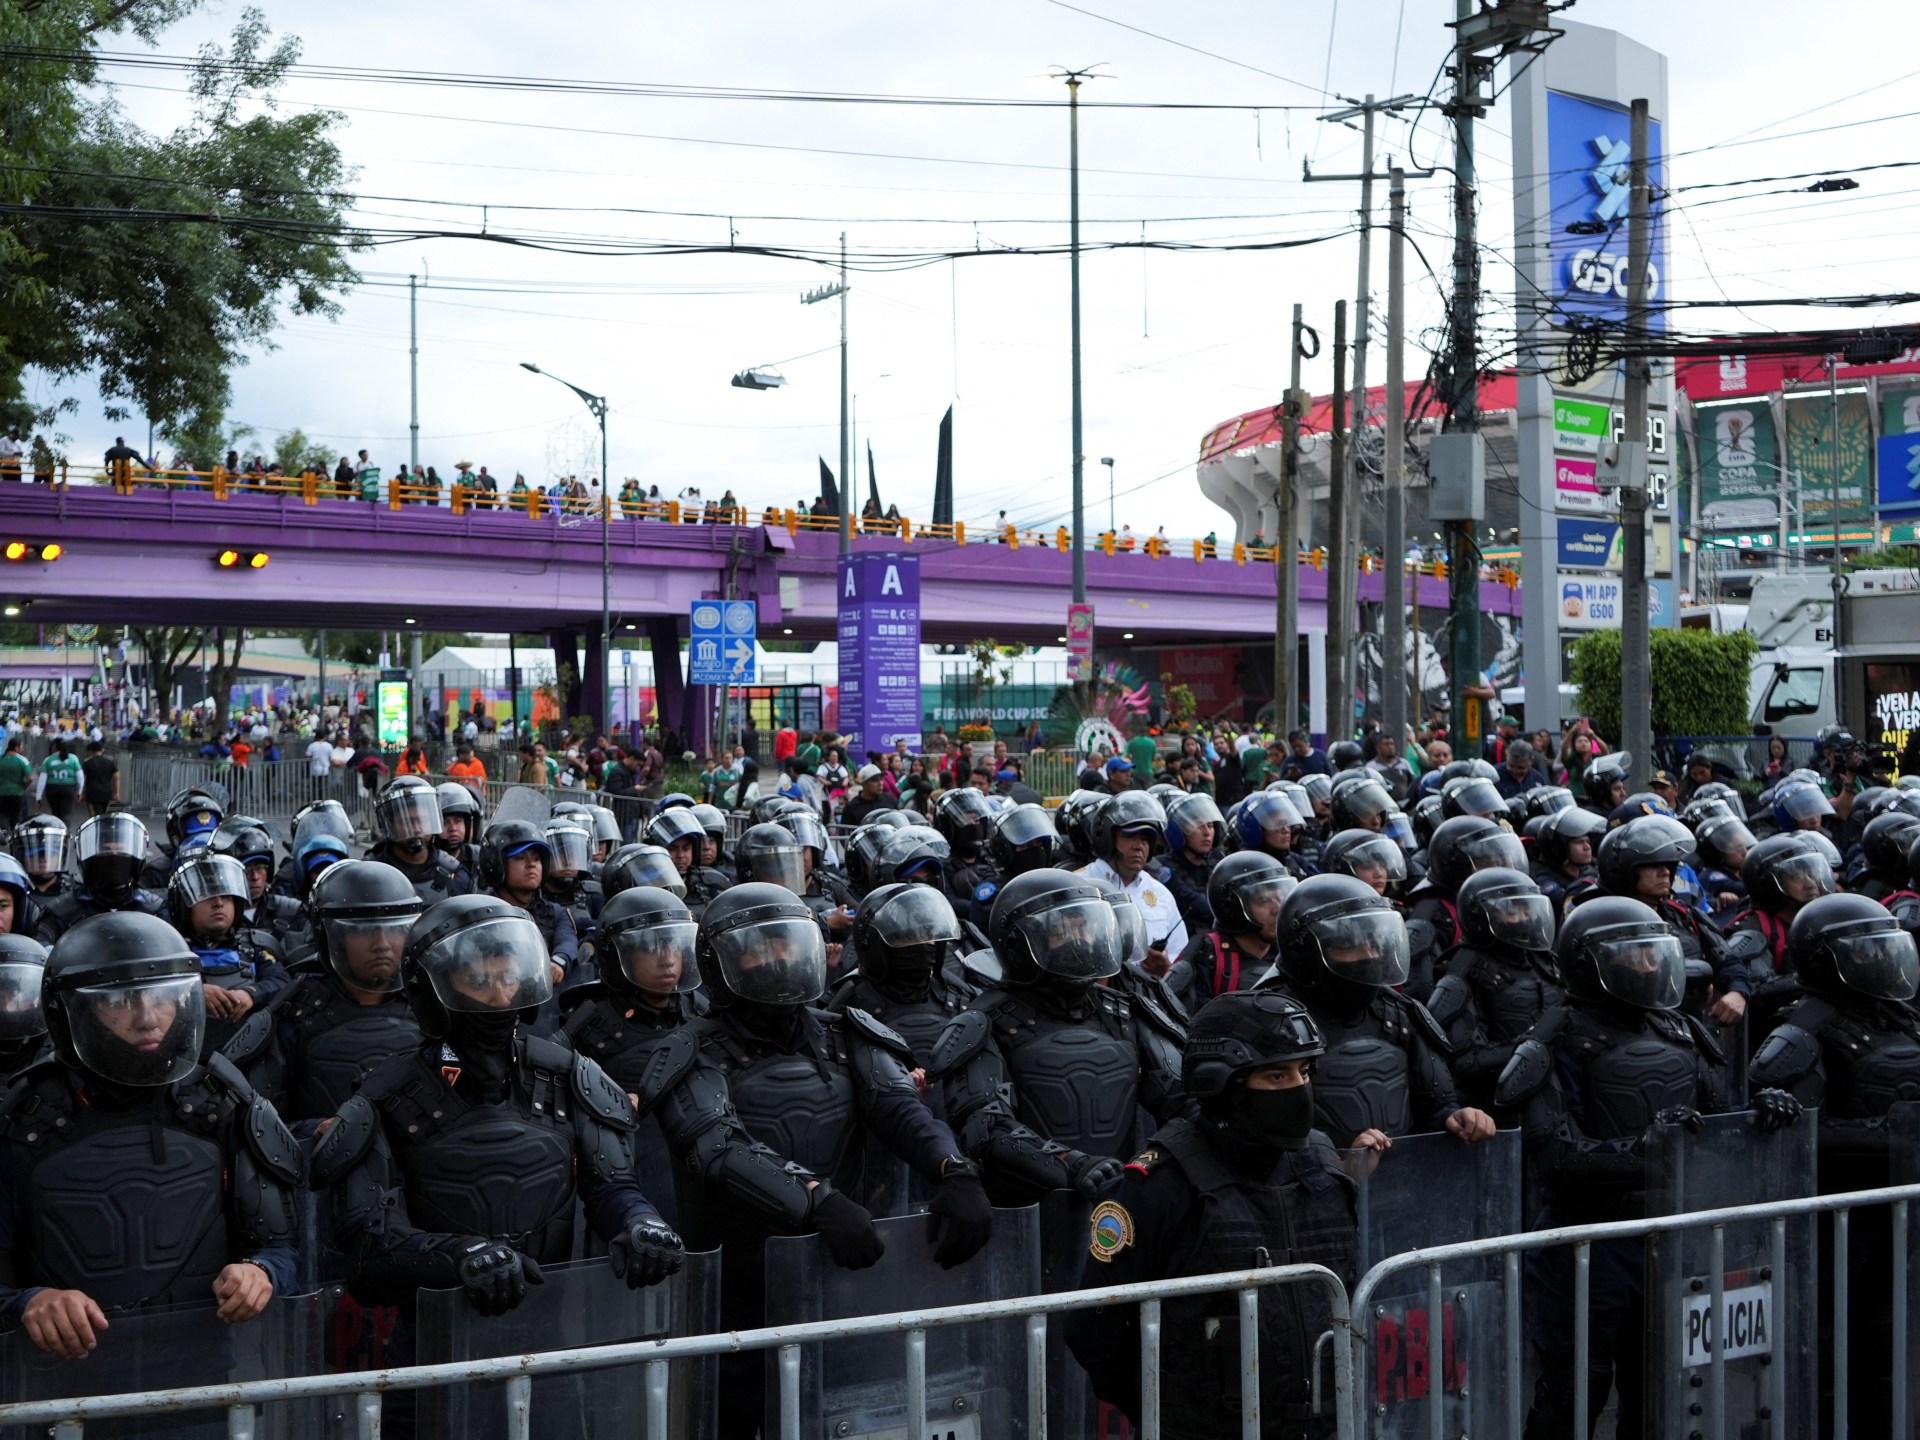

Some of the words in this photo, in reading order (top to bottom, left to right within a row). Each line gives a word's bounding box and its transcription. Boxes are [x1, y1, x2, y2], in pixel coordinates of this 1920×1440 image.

[1718, 466, 1757, 480] COPA
[844, 567, 857, 598] A
[881, 565, 903, 595] A
[1586, 584, 1597, 599] MI
[1600, 585, 1617, 601] APP
[1590, 603, 1614, 619] G500
[933, 708, 964, 720] FIFA
[965, 708, 1006, 720] WORLD
[1007, 707, 1030, 720] CUP
[1882, 713, 1891, 731] Y
[1689, 1299, 1766, 1356] POICIA
